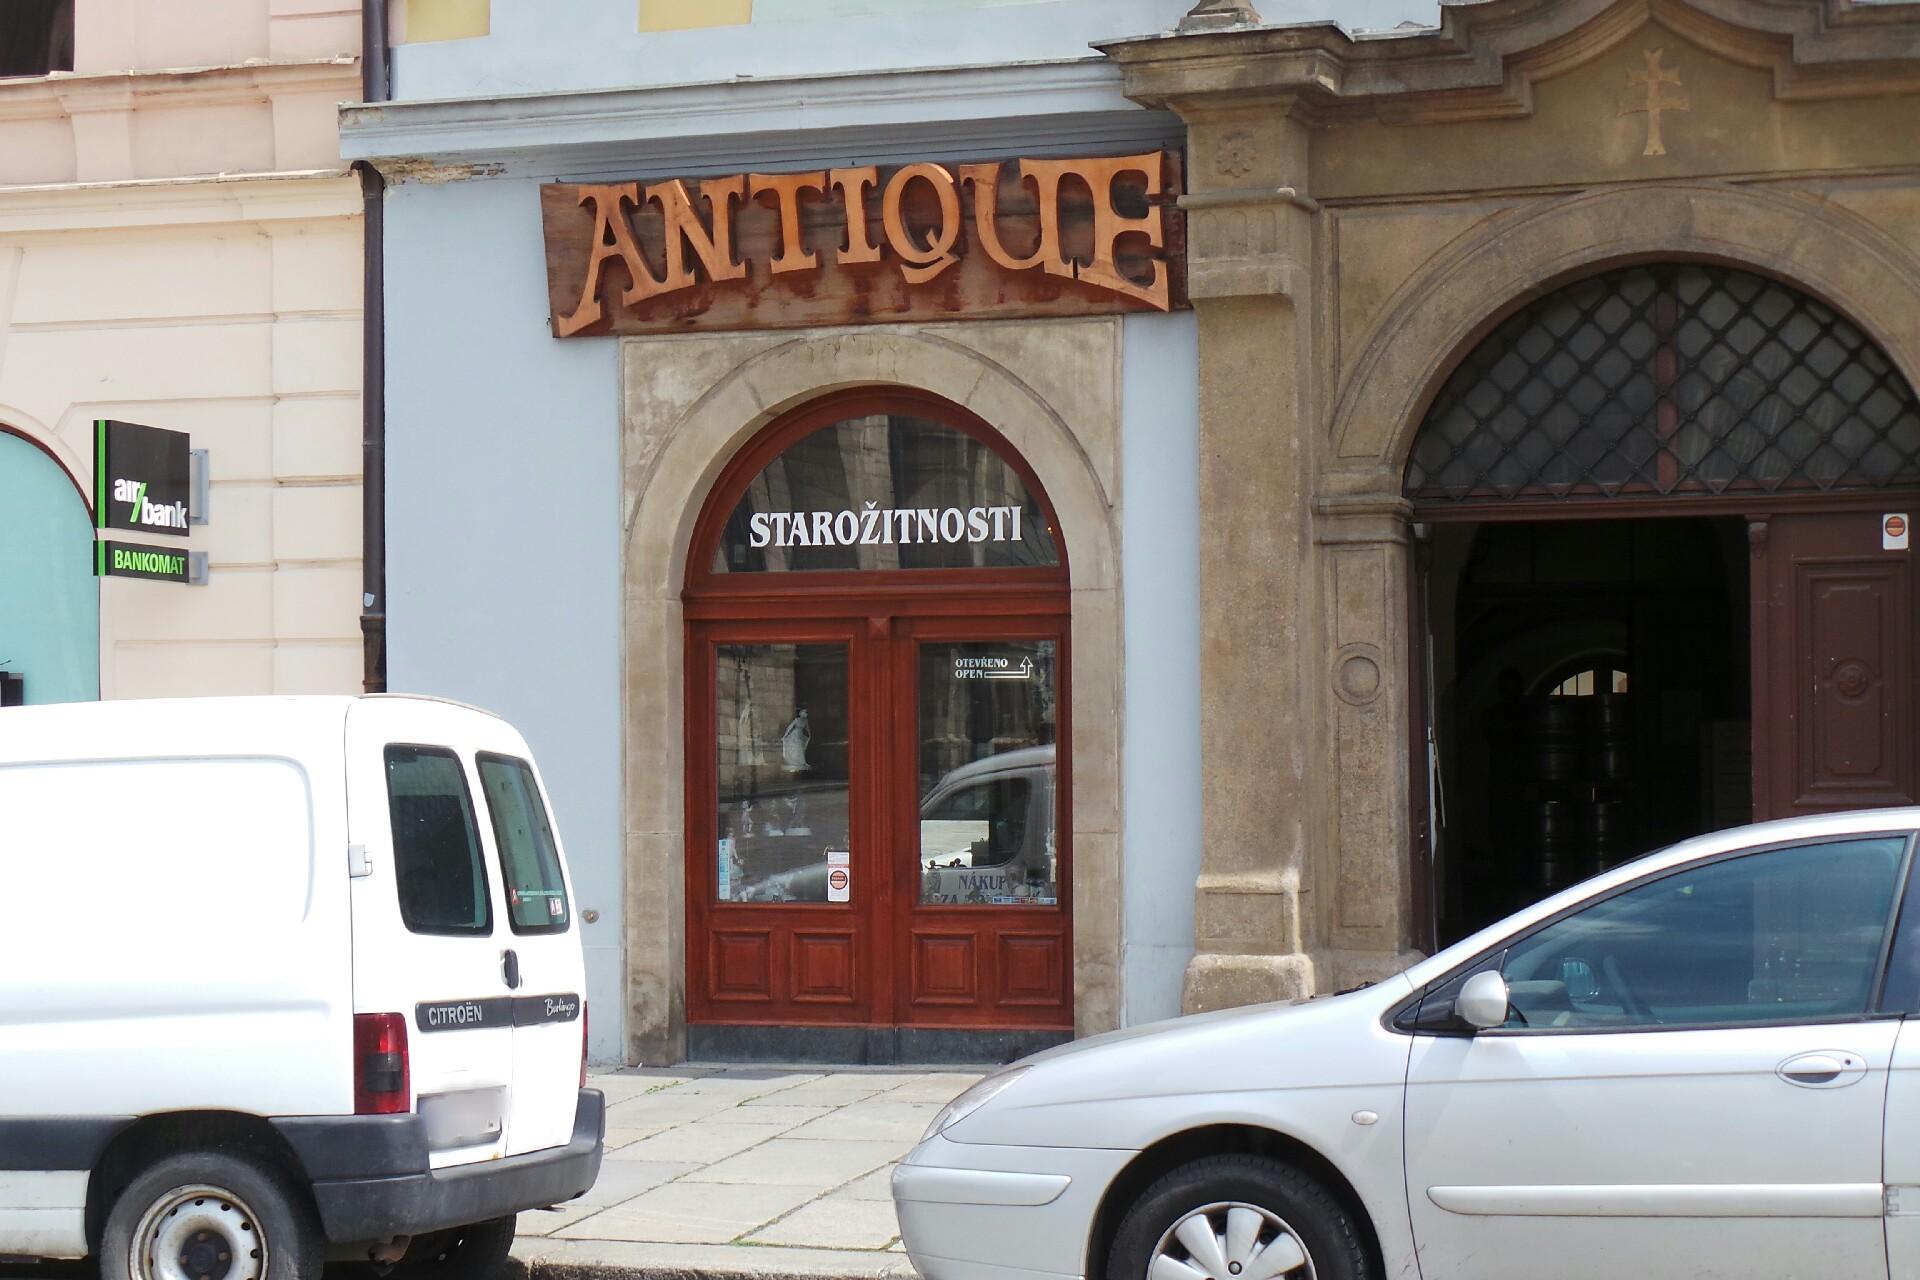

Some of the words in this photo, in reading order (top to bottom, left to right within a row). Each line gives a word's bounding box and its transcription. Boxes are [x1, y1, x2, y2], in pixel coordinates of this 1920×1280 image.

[558, 150, 1170, 338] ANTIQUE
[141, 495, 188, 529] bank
[749, 500, 1022, 548] STAROŽITNOSTI
[114, 549, 185, 575] BANKOMAT
[955, 656, 1009, 668] OTEVŘENO
[955, 669, 983, 679] OPEN
[428, 1002, 482, 1026] CITROËN
[544, 997, 576, 1017] Berlingo
